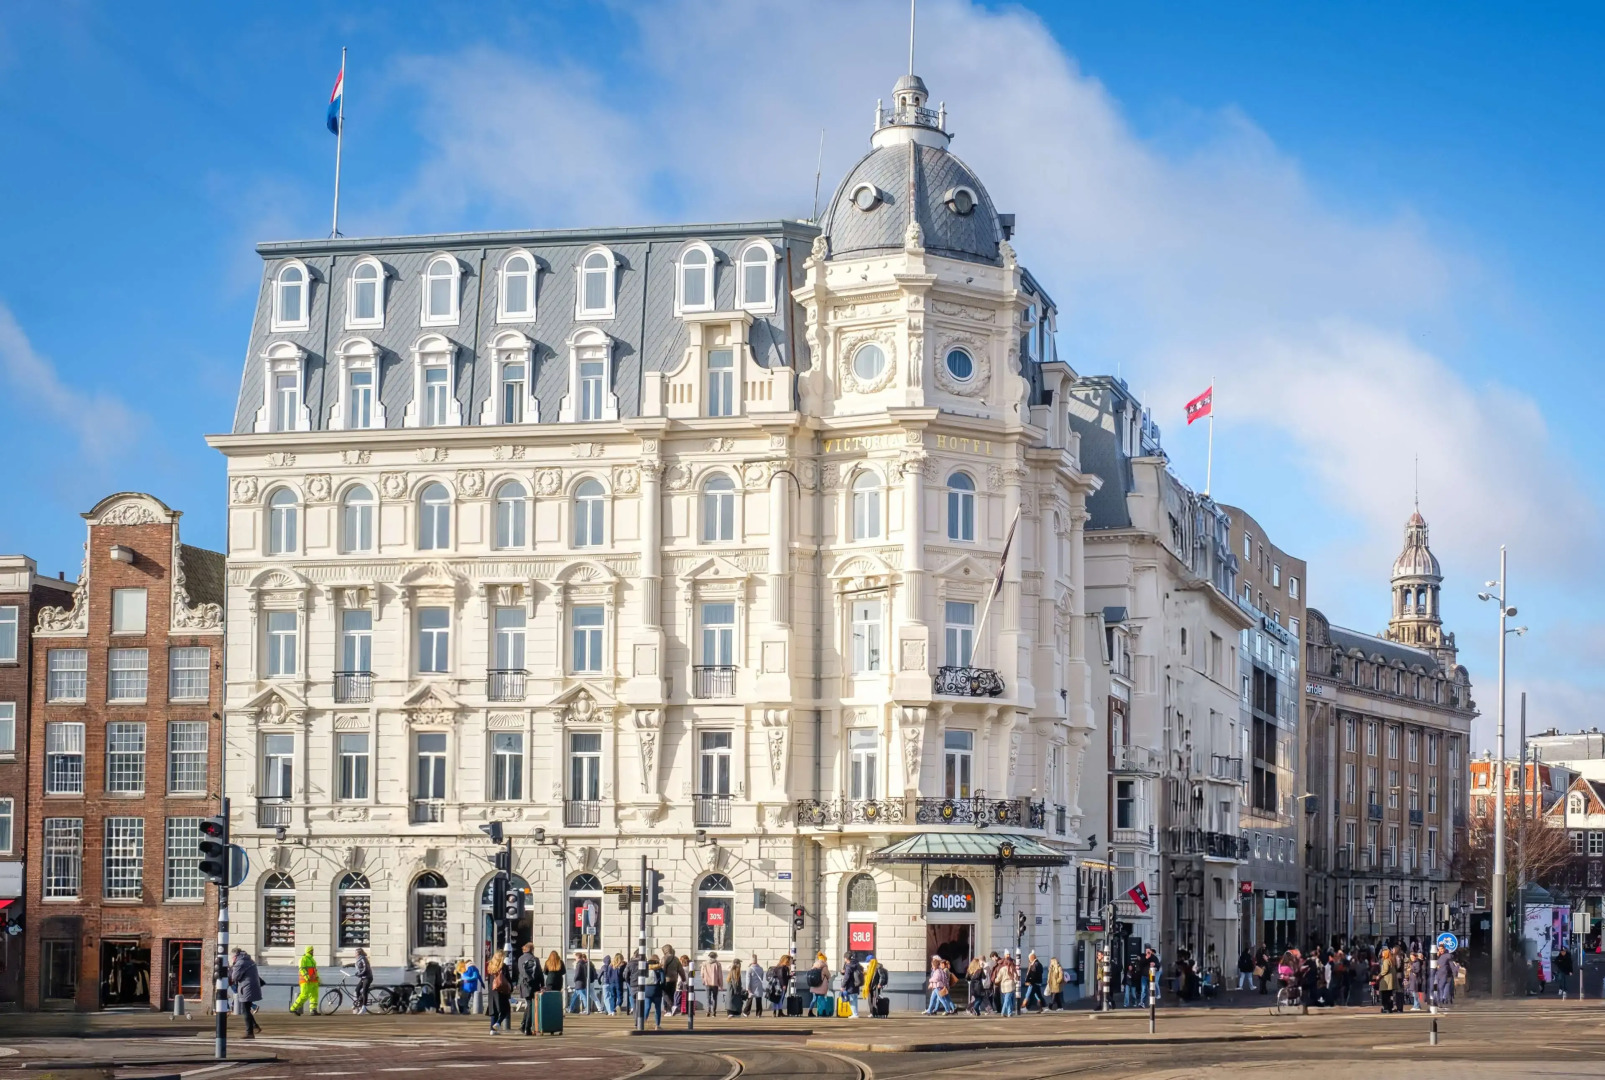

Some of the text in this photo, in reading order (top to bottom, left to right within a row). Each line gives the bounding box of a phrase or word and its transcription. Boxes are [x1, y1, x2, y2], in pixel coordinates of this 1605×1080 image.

[823, 434, 993, 455] VICTORIA HOTEL
[931, 893, 967, 911] snipes
[852, 931, 871, 942] sale
